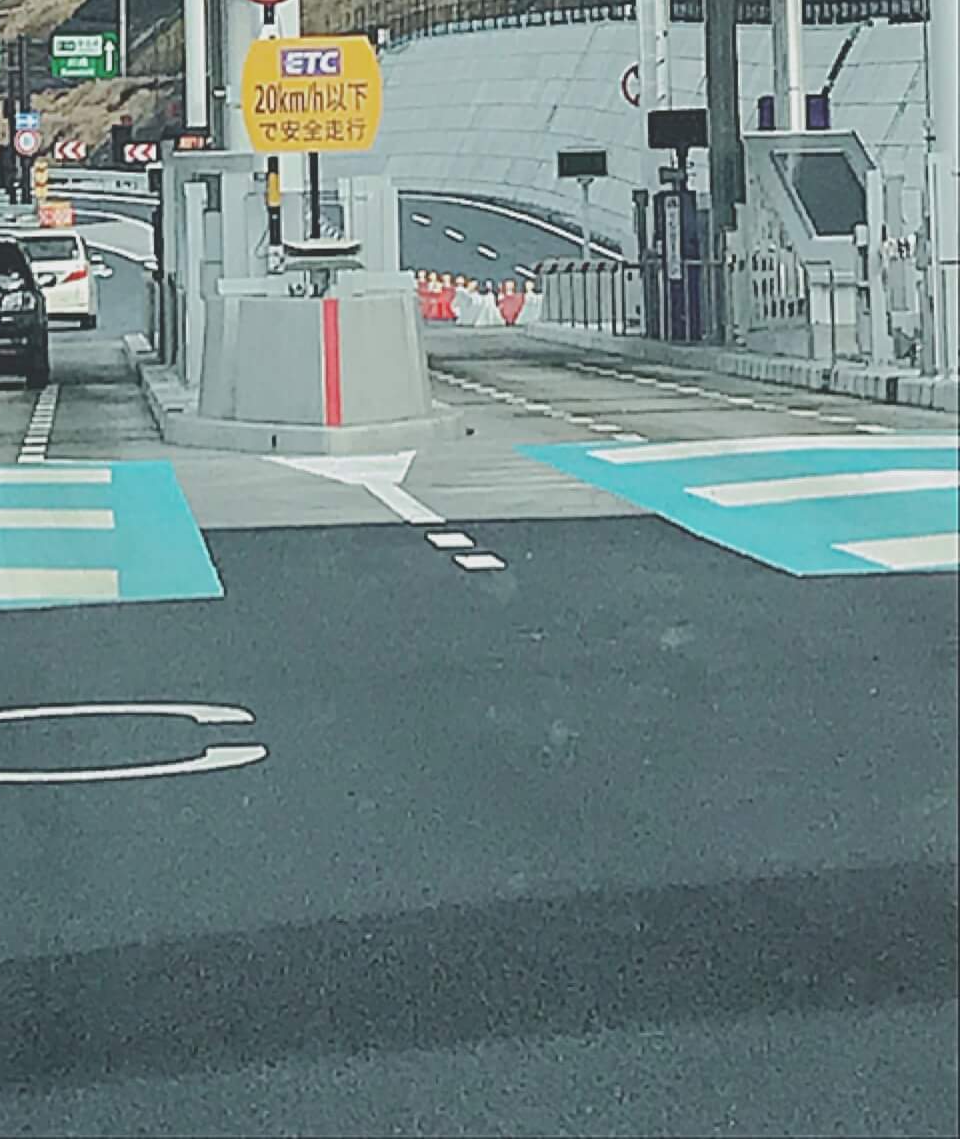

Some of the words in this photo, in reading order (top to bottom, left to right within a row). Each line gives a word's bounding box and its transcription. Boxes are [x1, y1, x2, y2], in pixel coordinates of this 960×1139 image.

[285, 51, 338, 75] ETC
[254, 81, 369, 114] 20km/h以下
[258, 118, 368, 142] で安全走行
